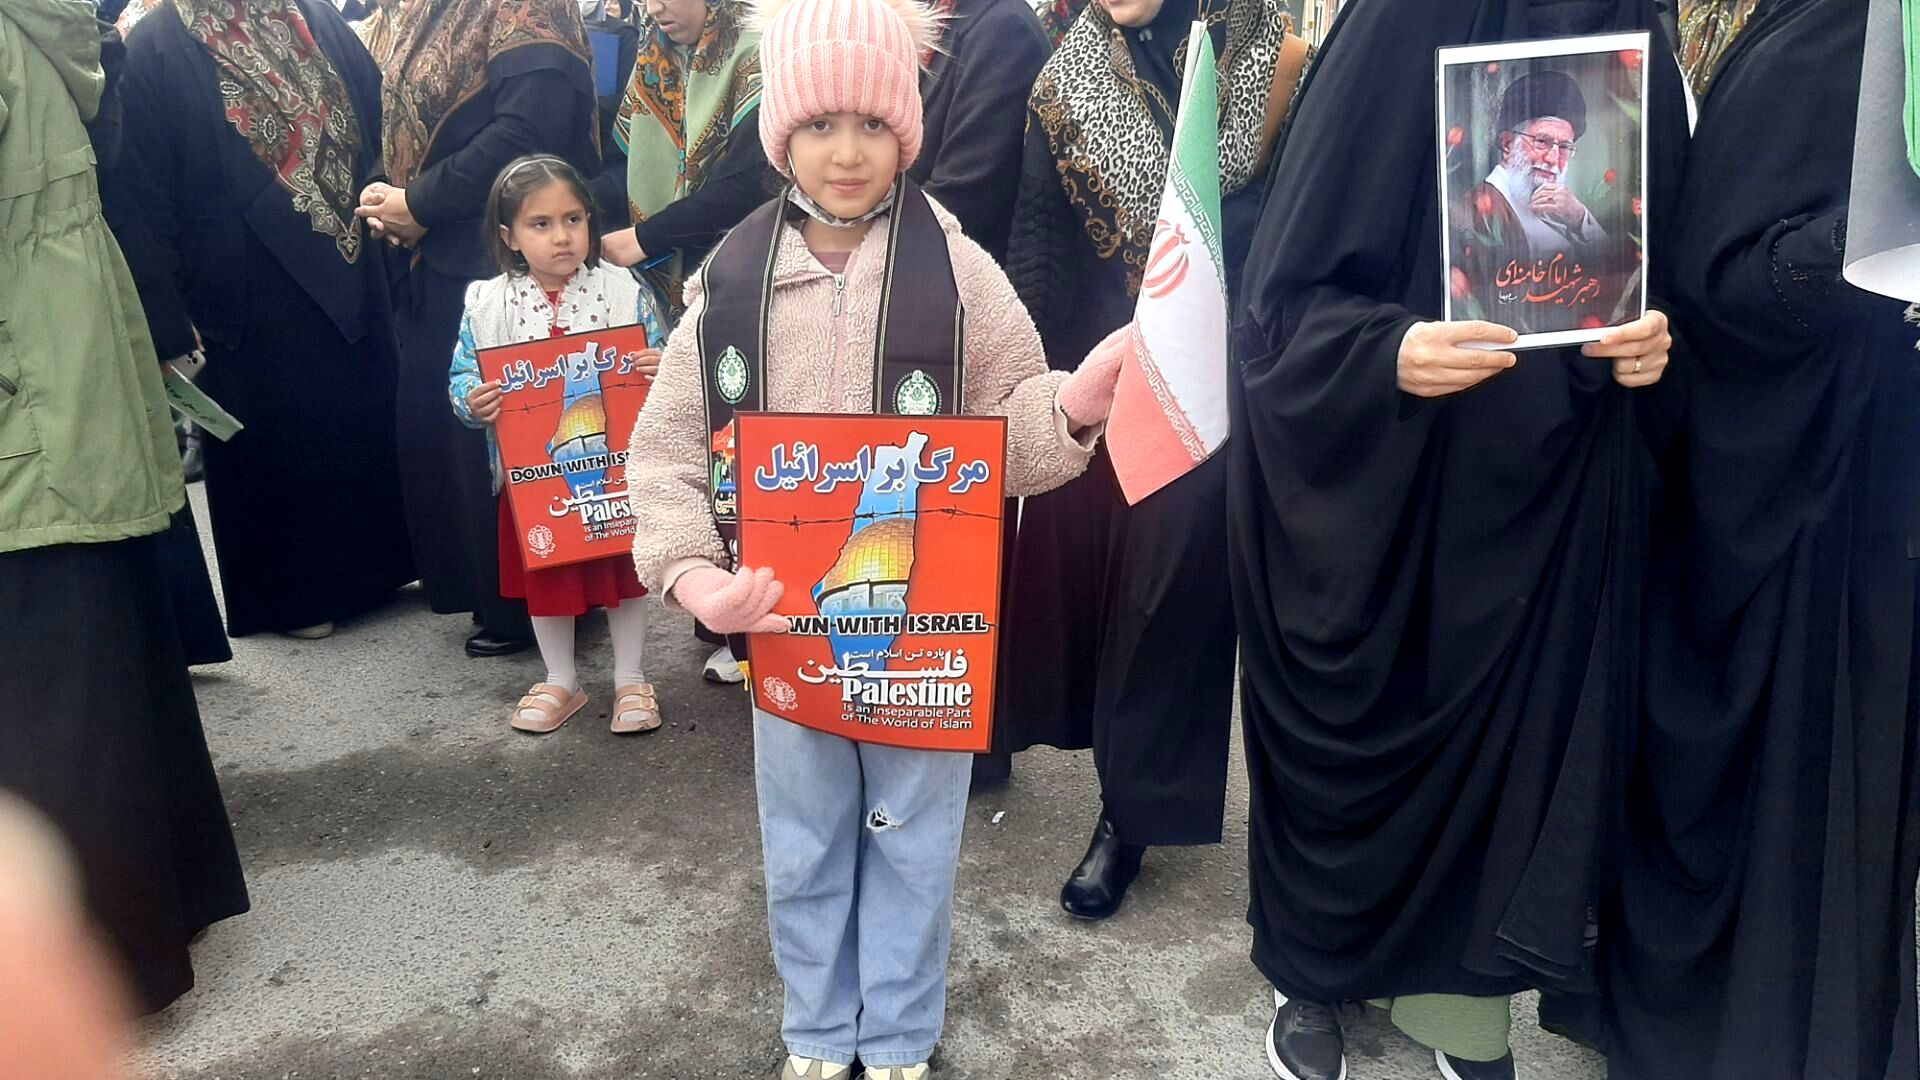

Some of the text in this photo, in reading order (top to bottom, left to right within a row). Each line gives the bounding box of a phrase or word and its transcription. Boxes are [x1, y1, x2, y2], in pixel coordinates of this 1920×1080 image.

[1549, 252, 1567, 285] امام
[1520, 263, 1583, 304] شهید
[1568, 277, 1600, 308] رهبر
[500, 346, 632, 393] رگ بر اسرائیل
[510, 463, 563, 484] DOWN
[565, 454, 608, 473] WITH
[755, 441, 990, 496] مرگ بر اسرائیل
[579, 499, 633, 524] Pales
[592, 523, 603, 531] an
[604, 517, 638, 529] Insepara
[584, 533, 594, 542] of
[595, 531, 609, 540] The
[789, 613, 988, 635] WN WITH ISRAEL
[797, 648, 968, 684] فلسطین
[850, 649, 874, 659] است
[876, 648, 902, 661] اسلام
[841, 677, 972, 707] Palestine
[841, 712, 855, 721] of
[857, 713, 879, 725] The
[881, 717, 918, 728] World
[921, 719, 935, 729] of
[843, 702, 971, 718] Is an Inseparable Part
